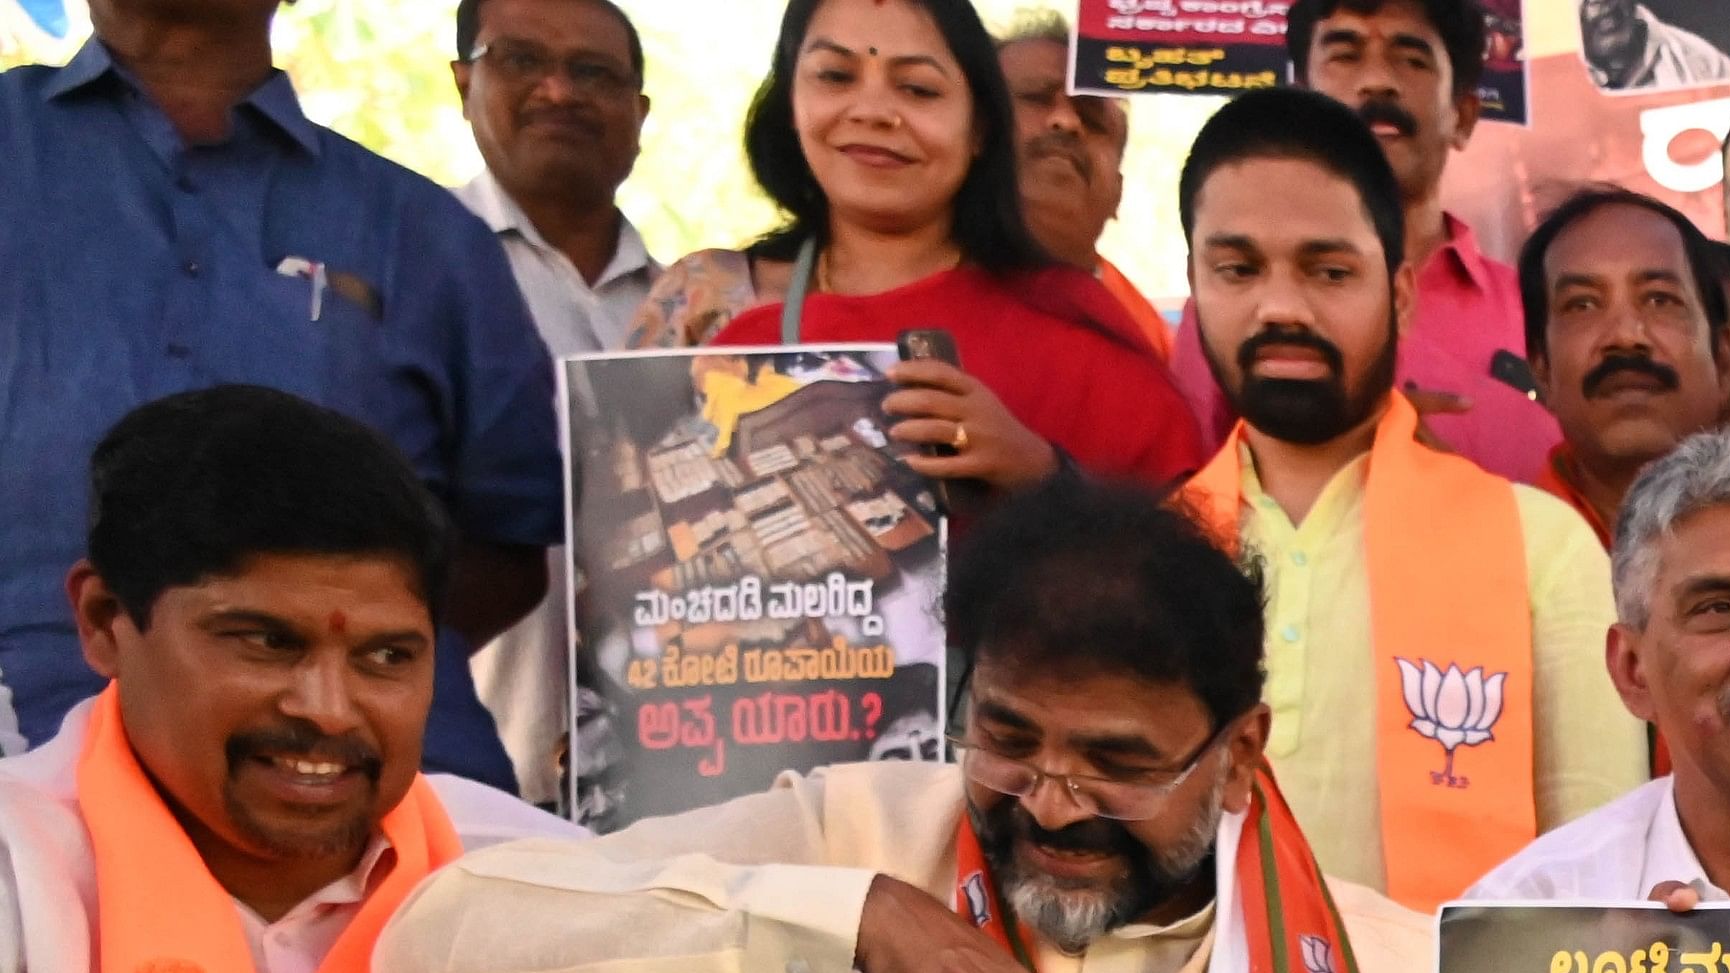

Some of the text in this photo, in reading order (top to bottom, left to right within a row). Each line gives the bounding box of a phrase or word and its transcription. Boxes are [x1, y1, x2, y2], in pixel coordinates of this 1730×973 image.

[634, 572, 883, 636] ಮಂಚದಡಿ ಮಲಗಿದ್ದ
[628, 636, 895, 688] 42 ಕೋಟಿ ರೂಪಾಯಿಯ
[638, 694, 725, 777] ಅಪ್ಪ
